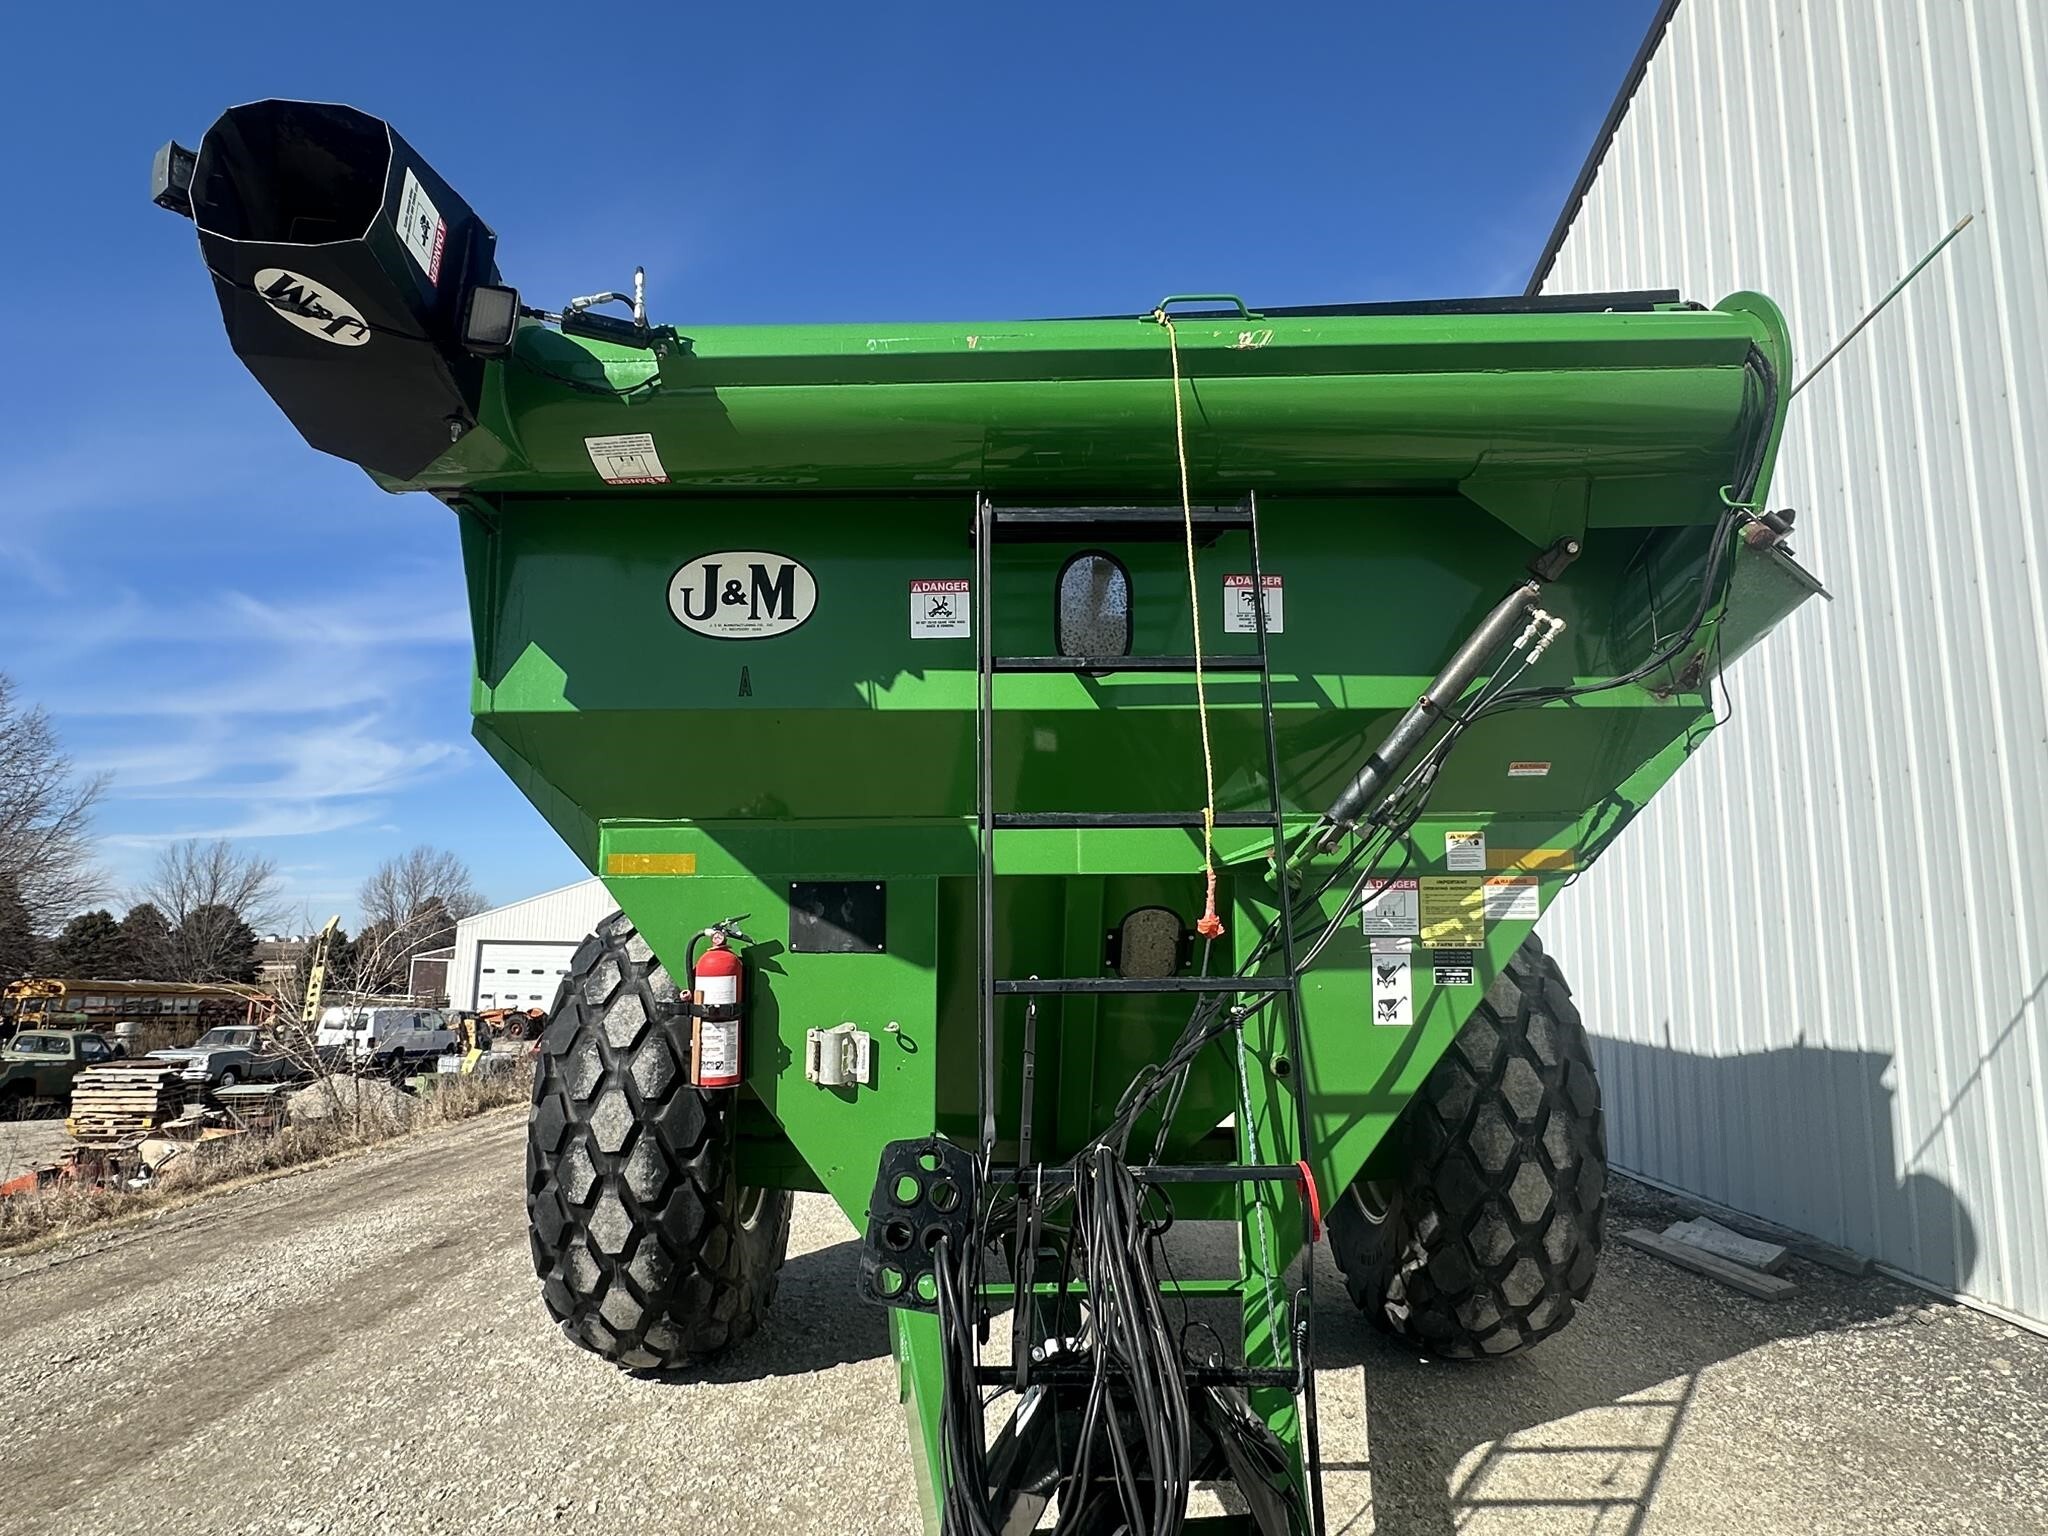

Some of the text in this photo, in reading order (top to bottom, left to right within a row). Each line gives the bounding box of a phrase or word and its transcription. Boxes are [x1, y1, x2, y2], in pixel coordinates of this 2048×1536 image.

[429, 233, 446, 284] DANGER
[1236, 576, 1282, 586] DAGER
[922, 582, 969, 592] DANGER
[680, 564, 798, 621] J&M
[1375, 880, 1417, 889] DNGER
